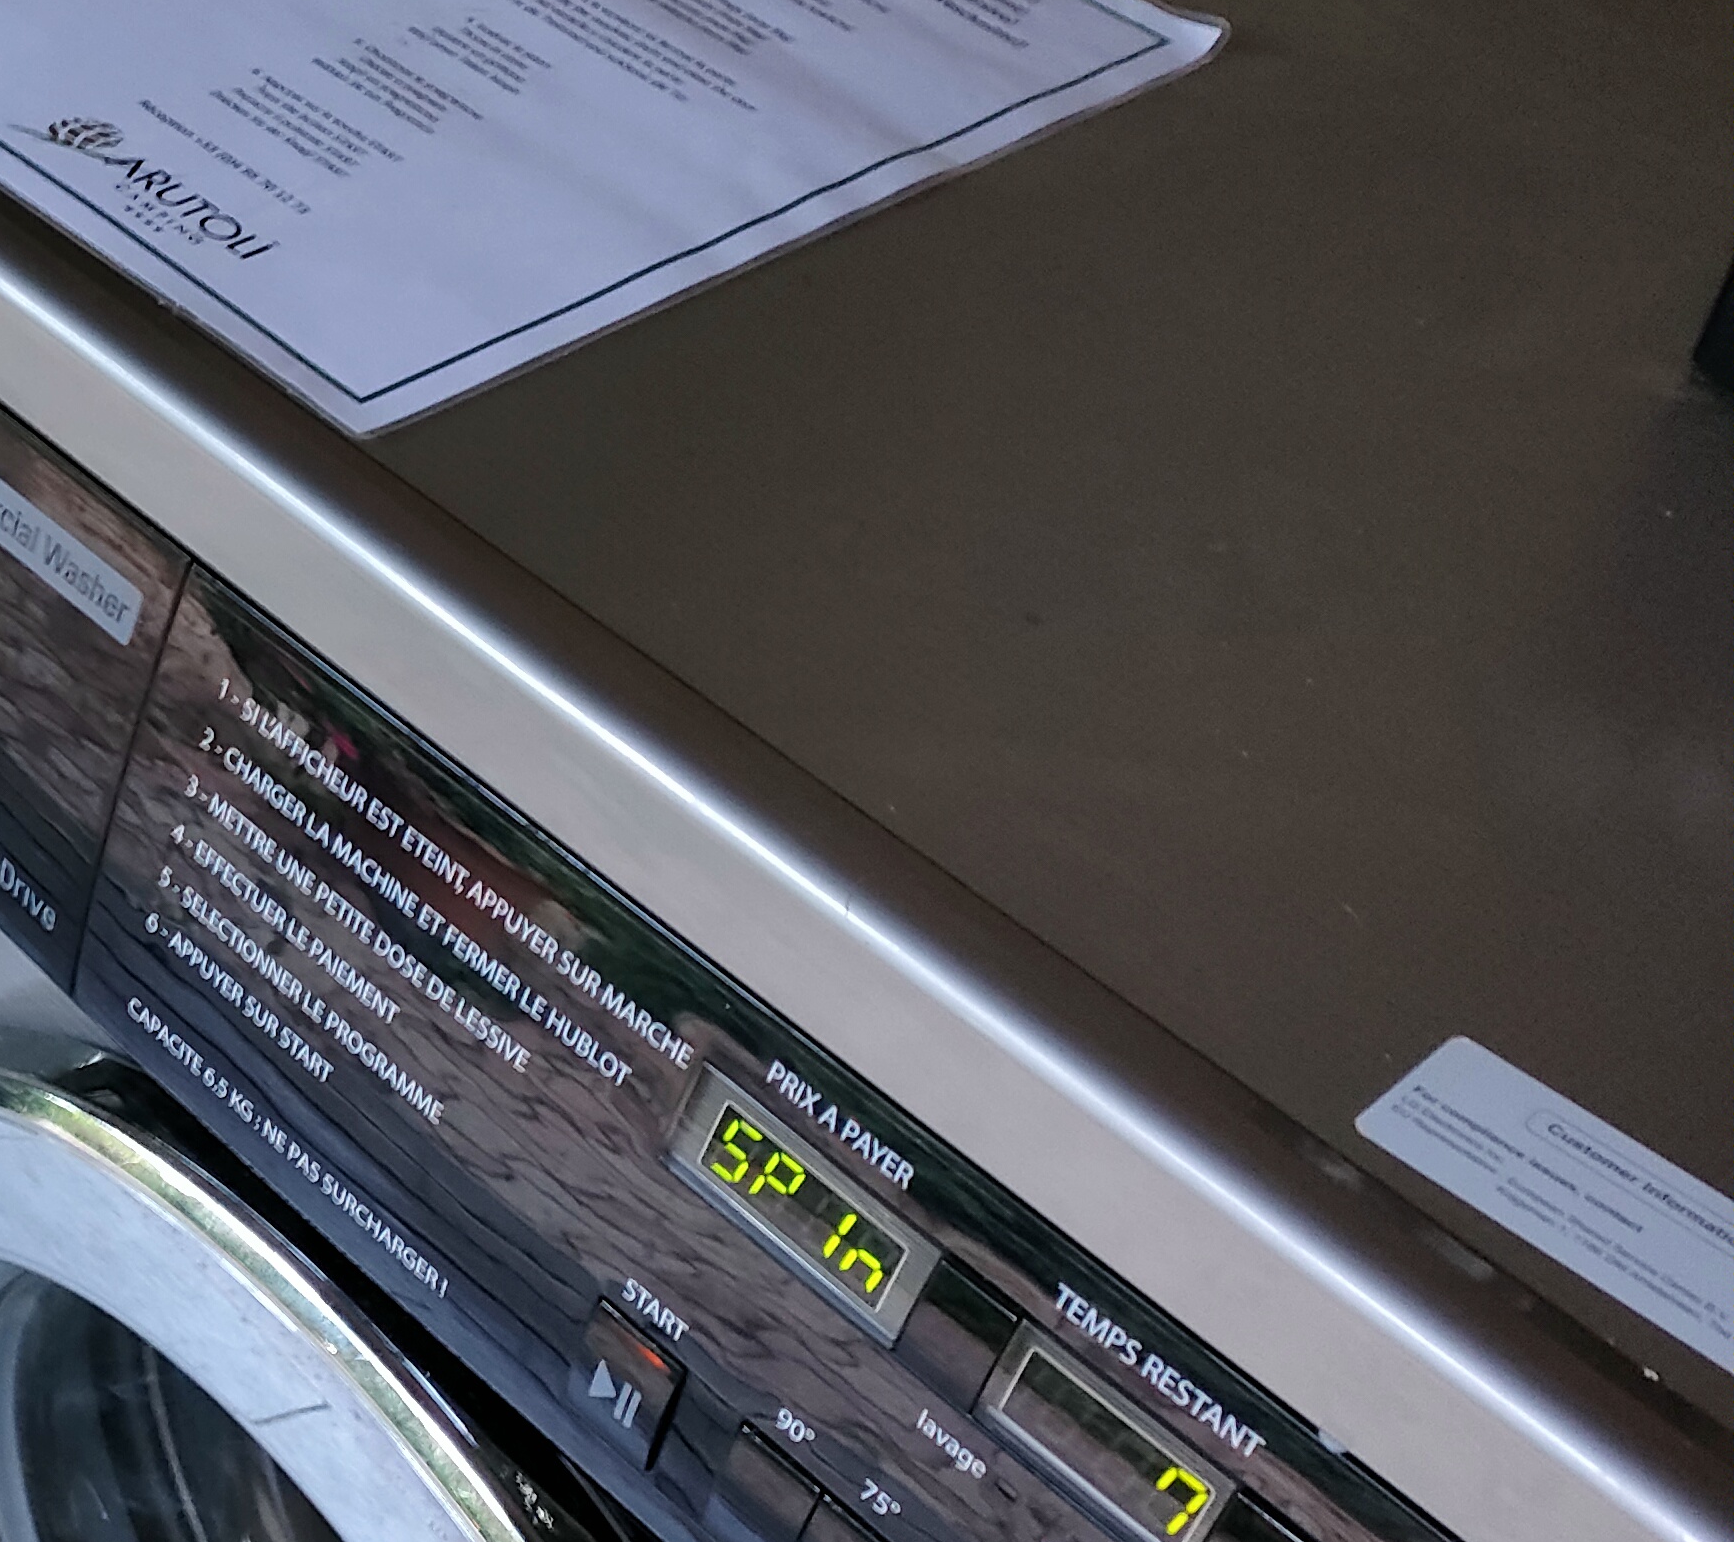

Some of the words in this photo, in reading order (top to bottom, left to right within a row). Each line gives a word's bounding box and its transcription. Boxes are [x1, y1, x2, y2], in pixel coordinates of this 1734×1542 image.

[104, 158, 280, 260] ARUTOLI
[44, 536, 129, 622] Washer
[170, 824, 185, 844] 4
[194, 840, 287, 931] EFFECTUER
[285, 917, 310, 951] LE
[309, 938, 400, 1023] PAIEMENT
[184, 774, 199, 798] 3
[208, 794, 277, 863] METTRE
[275, 849, 316, 895] UNE
[314, 882, 375, 944] PETITE
[373, 930, 427, 988] DOSE
[425, 974, 456, 1012] DE
[455, 998, 530, 1072] LESSIVE
[198, 726, 215, 751] 2
[223, 747, 306, 826] CHARGER
[304, 812, 330, 848] LA
[331, 834, 419, 917] MACHINE
[417, 903, 446, 936] ET
[443, 924, 520, 1000] FERMER
[518, 986, 548, 1022] LE
[545, 1008, 632, 1085] HUBLOT
[218, 678, 230, 700] 1
[239, 698, 264, 726] SI
[259, 713, 367, 812] L'AFFICHEUR
[366, 797, 405, 837] EST
[401, 826, 470, 894] ETEINT,
[466, 881, 558, 963] APPUYER
[557, 950, 601, 998] SUR
[600, 984, 694, 1069] MARCHE
[145, 912, 160, 934] 6
[168, 932, 244, 1007] APPUYER
[242, 995, 279, 1038] SUR
[278, 1027, 334, 1082] START
[158, 865, 173, 888] 5
[182, 887, 302, 1003] SELECTIONNER
[301, 990, 326, 1024] LE
[325, 1011, 443, 1124] PROGRAMME
[127, 998, 203, 1075] CAPACITE
[202, 1067, 229, 1098] 6,5
[228, 1088, 254, 1122] KG
[261, 1118, 287, 1153] NE
[286, 1141, 321, 1182] PAS
[321, 1174, 438, 1289] SURCHARGER
[766, 1061, 822, 1116] PRIX
[817, 1104, 838, 1133] A
[840, 1119, 914, 1189] PAYER
[1546, 1122, 1639, 1183] Customer
[622, 1278, 689, 1341] START
[1056, 1283, 1142, 1365] TEMPS
[1141, 1355, 1265, 1456] RESTANT
[917, 1409, 986, 1478] lavage
[1156, 1466, 1209, 1536] 7
